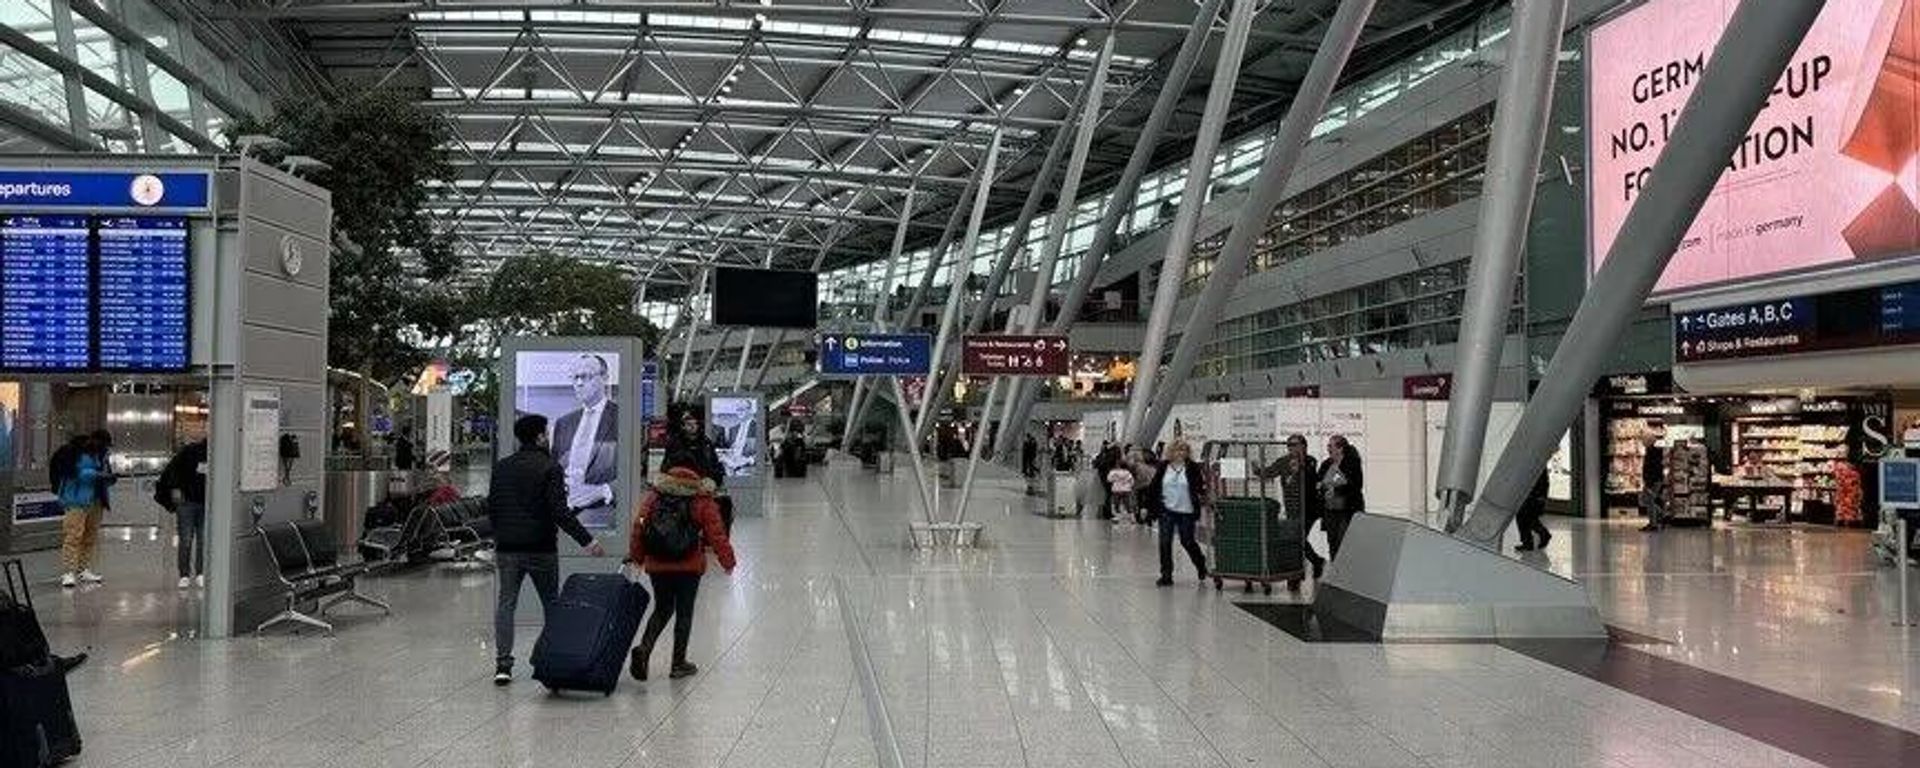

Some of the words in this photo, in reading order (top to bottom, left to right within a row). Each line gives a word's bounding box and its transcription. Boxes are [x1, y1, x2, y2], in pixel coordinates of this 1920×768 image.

[1632, 51, 1704, 104] GERM
[1611, 122, 1655, 159] NO.
[1755, 215, 1803, 236] germany
[1706, 312, 1746, 328] Gates
